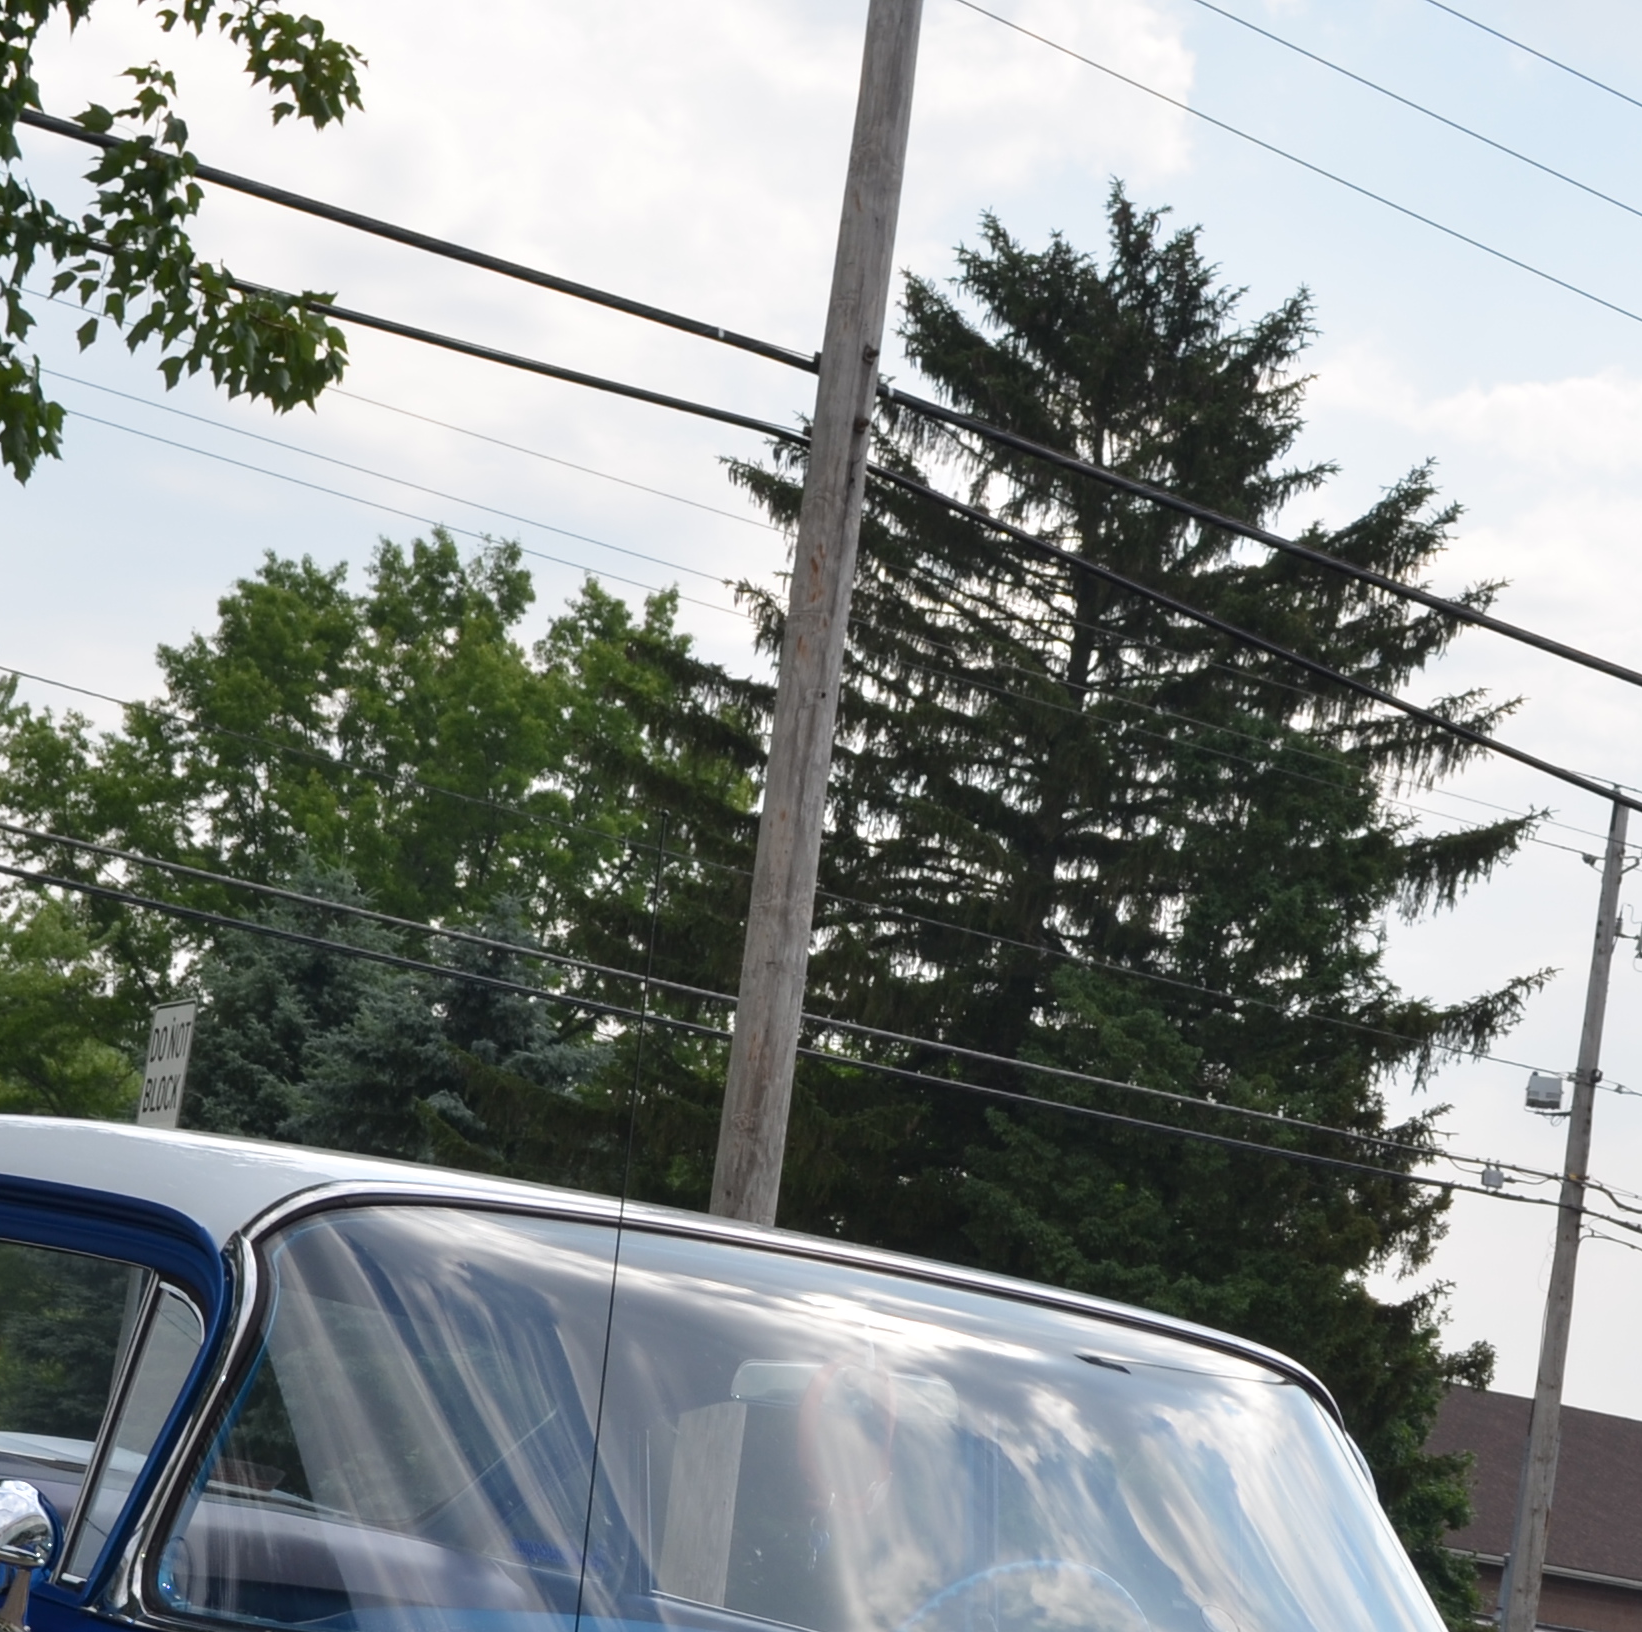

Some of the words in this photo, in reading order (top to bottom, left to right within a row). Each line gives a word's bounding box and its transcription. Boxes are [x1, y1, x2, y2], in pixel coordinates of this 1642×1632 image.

[150, 1026, 168, 1063] DO
[167, 1022, 192, 1060] NOT
[142, 1074, 181, 1113] BLOCK
